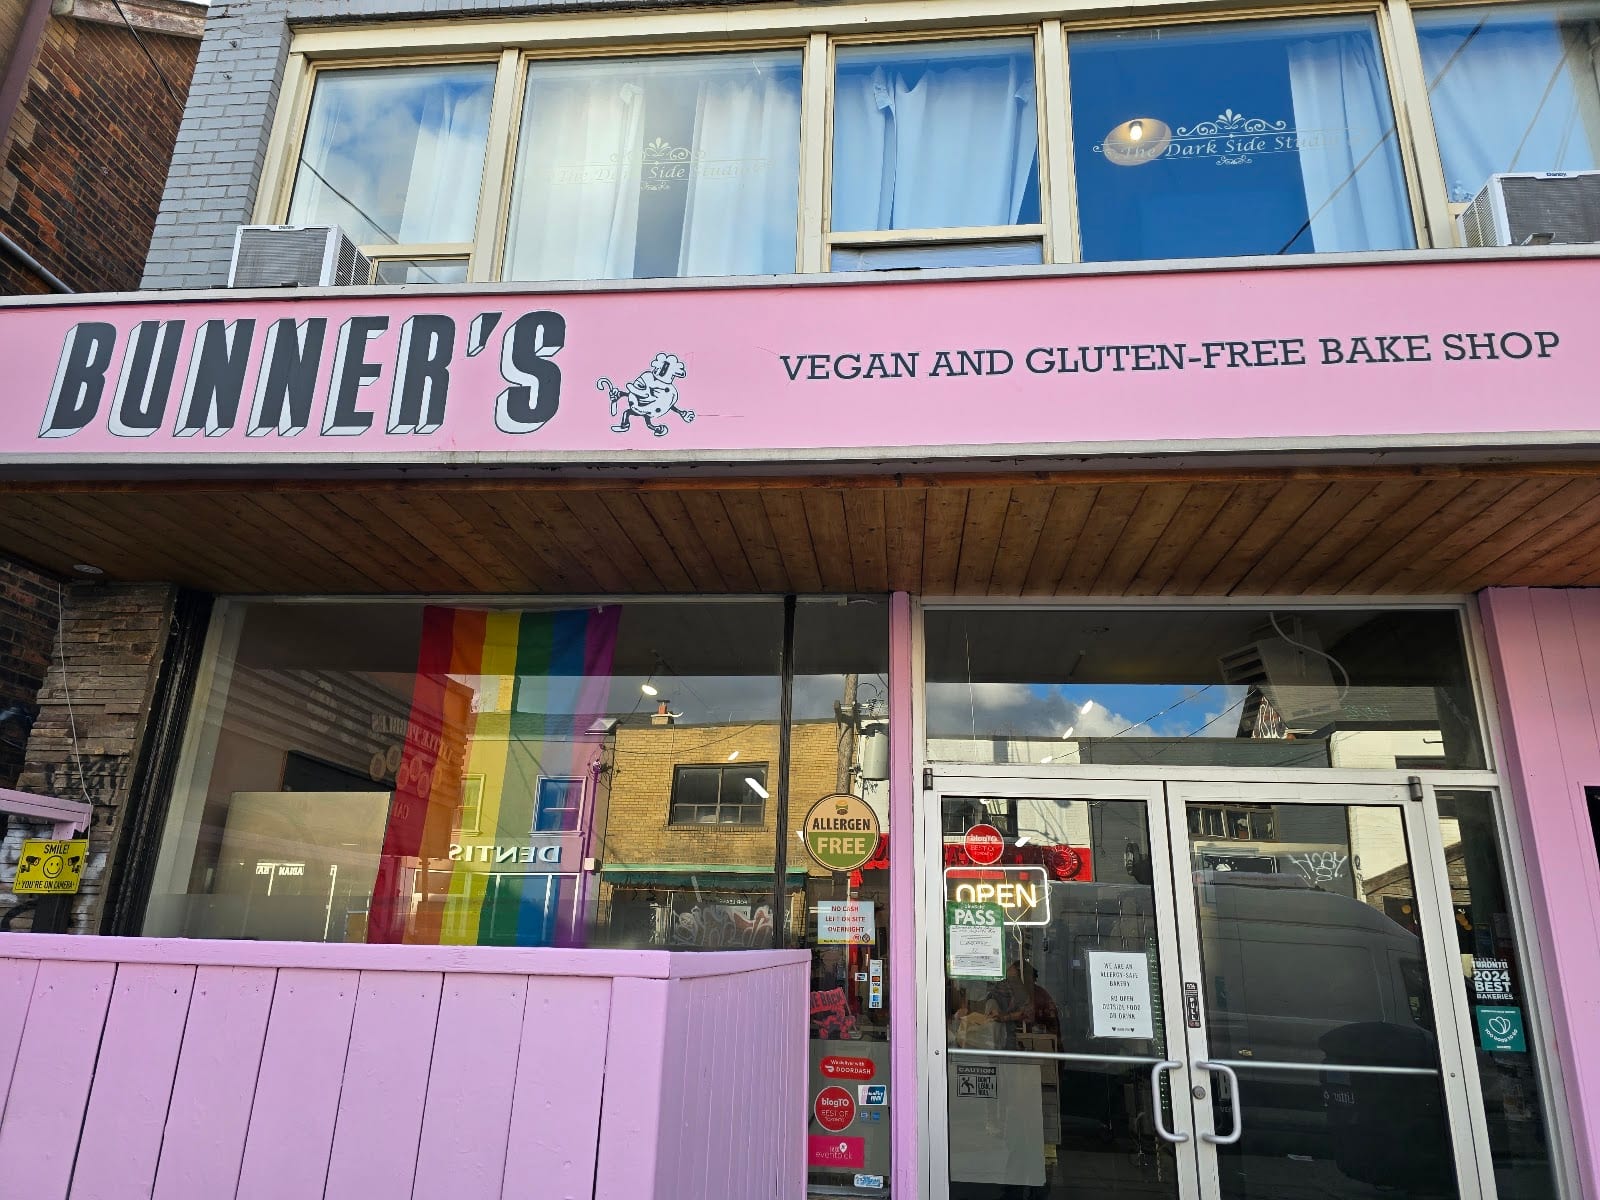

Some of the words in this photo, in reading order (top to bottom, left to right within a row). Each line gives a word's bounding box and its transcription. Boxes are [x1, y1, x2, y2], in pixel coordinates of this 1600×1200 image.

[1165, 140, 1216, 157] Dark
[1225, 137, 1266, 153] Side
[650, 165, 686, 178] Side
[780, 353, 919, 380] VEGAN
[929, 350, 1013, 376] AND
[1026, 339, 1305, 373] GLUTEN-FREE
[1319, 335, 1431, 364] BAKE
[1443, 332, 1559, 360] SHOP
[38, 310, 567, 438] BUNNER'S
[812, 818, 871, 831] ALLERGEN
[43, 843, 70, 855] SMILE!
[817, 836, 865, 855] FREE
[955, 882, 1038, 908] OPEN
[954, 908, 996, 926] PASS
[1473, 970, 1510, 981] 2024
[1475, 981, 1511, 992] BEST
[821, 1097, 850, 1108] blogTO
